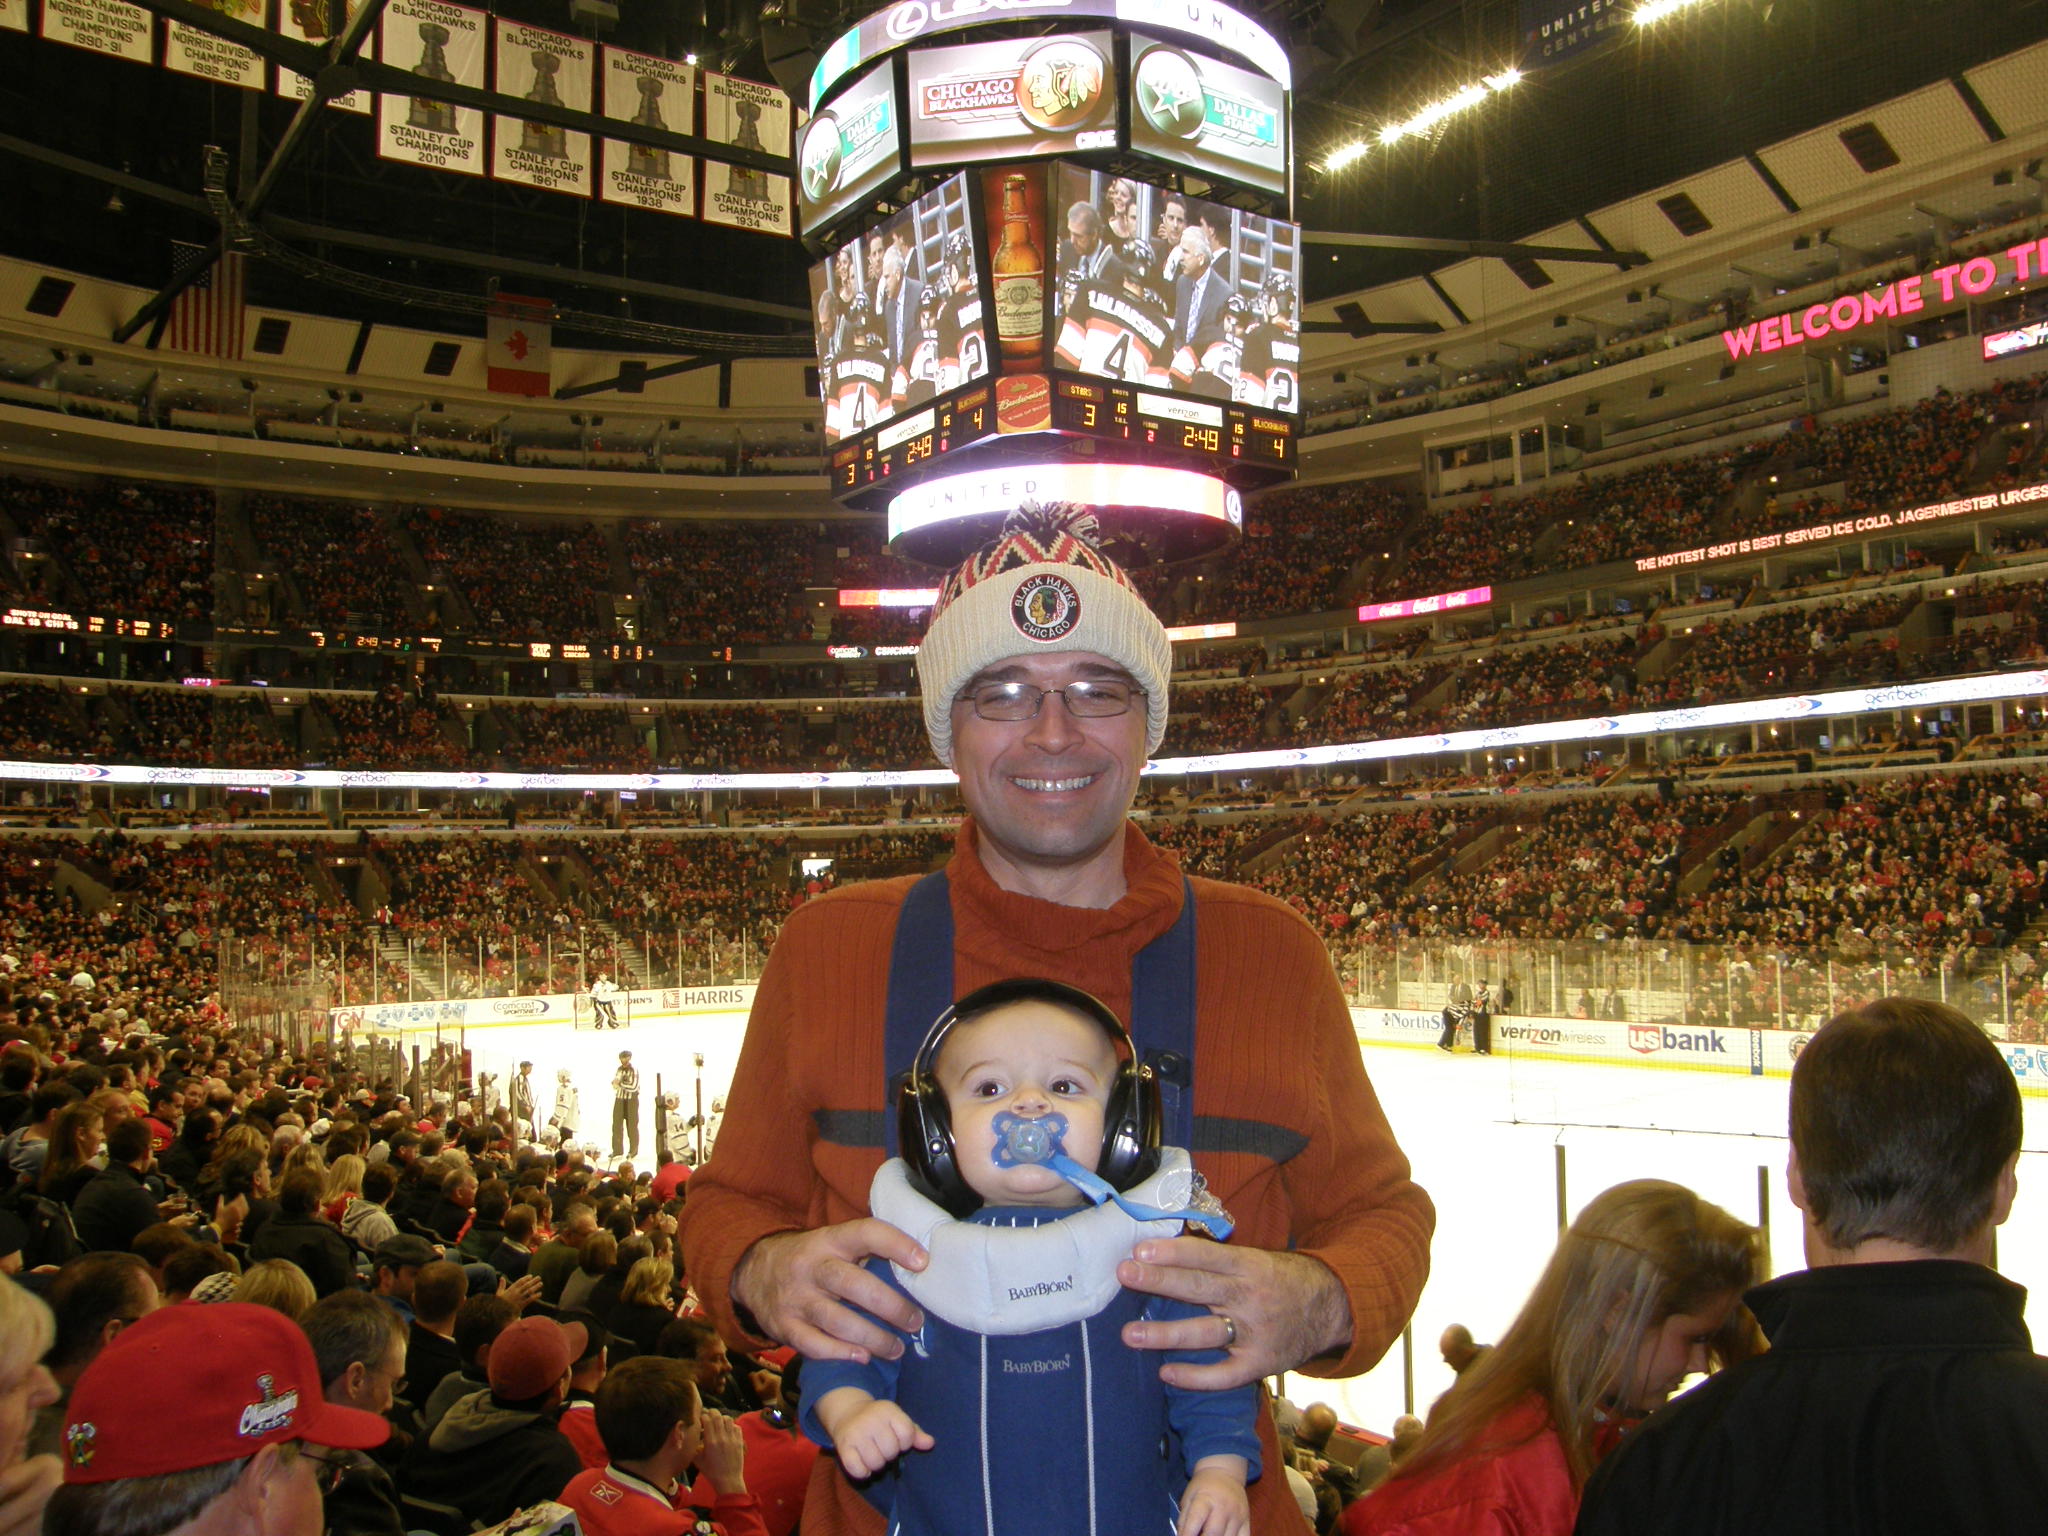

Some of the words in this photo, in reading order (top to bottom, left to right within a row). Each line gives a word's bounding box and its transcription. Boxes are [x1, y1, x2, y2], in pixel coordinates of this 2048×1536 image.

[48, 1, 94, 20] NORRIS
[97, 12, 147, 33] DIVISION
[392, 3, 477, 31] BLACKHAWKS
[405, 0, 463, 18] CHICAGO
[1541, 0, 1615, 37] UNITED
[61, 17, 134, 43] CHAMPIONS
[172, 30, 213, 50] NORRIS
[519, 27, 572, 48] CHICAGO
[74, 32, 123, 53] 1990-91
[506, 33, 585, 60] BLACKHAWKS
[184, 47, 250, 71] CHAMPIONS
[625, 53, 675, 73] CHICAGO
[193, 61, 240, 81] 1992-93
[612, 59, 687, 85] BLACKHAWKS
[713, 84, 784, 109] BLACKHAWKS
[726, 78, 772, 98] CHICAGO
[926, 78, 1015, 101] CHICAGO
[928, 92, 1015, 113] BLACKHAWKS
[1213, 97, 1266, 127] DALLAS
[389, 125, 444, 145] STANLEY
[449, 136, 475, 150] CUP
[395, 136, 470, 160] CHAMPIONS
[418, 152, 446, 166] 2010
[504, 148, 554, 167] STANLEY
[560, 160, 584, 173] CUP
[509, 160, 579, 184] CHAMPIONS
[532, 174, 558, 188] 1961
[611, 171, 660, 188] STANLEY
[663, 181, 687, 194] CUP
[616, 182, 682, 203] CHAMPIONS
[637, 195, 663, 209] 1938
[713, 193, 758, 209] STANLEY
[762, 202, 784, 214] CUP
[718, 203, 780, 223] CHAMPIONS
[735, 216, 761, 229] 1934
[1723, 277, 1925, 361] WELCOME
[1932, 256, 1997, 302] TO
[1104, 333, 1130, 379] 4
[1070, 385, 1092, 398] STARS
[973, 407, 983, 430] 4
[1083, 403, 1096, 427] 3
[1116, 402, 1128, 415] 15
[1167, 405, 1200, 418] verizon
[1124, 426, 1129, 439] 1
[1147, 429, 1155, 443] 2
[1183, 425, 1219, 452] 2:49
[1233, 423, 1244, 435] 15
[906, 434, 932, 464] 2:49
[1232, 444, 1240, 457] 0
[1273, 438, 1284, 458] 4
[847, 463, 855, 485] 3
[883, 462, 890, 475] 2
[929, 480, 1037, 508] UNITED
[1635, 558, 1657, 572] THE
[1657, 548, 1706, 568] HOTTEST
[1707, 542, 1738, 559] SHOT
[1739, 540, 1751, 553] IS
[1752, 534, 1782, 551] BEST
[1784, 525, 1832, 545] SERVED
[1832, 520, 1854, 536] ICE
[1855, 514, 1894, 532] COLD.
[1896, 494, 2000, 525] JAGERMEISTER
[2000, 484, 2048, 505] URGES
[1014, 577, 1043, 608] BLACK
[1046, 576, 1077, 608] HAWKS
[3, 615, 26, 625] DAL
[44, 619, 64, 628] CHI
[1022, 620, 1071, 639] CHICAGO
[317, 636, 326, 647] 3
[356, 635, 379, 648] 2:49
[147, 767, 199, 784] gerber
[341, 771, 390, 787] gerber
[496, 998, 536, 1011] comcast
[684, 989, 744, 1006] HARRIS
[1500, 1024, 1561, 1044] verizon
[1561, 1031, 1607, 1046] wireless
[1631, 1028, 1660, 1050] us
[1662, 1027, 1727, 1053] bank
[1750, 1030, 1761, 1068] Reebok
[674, 1122, 684, 1133] 14
